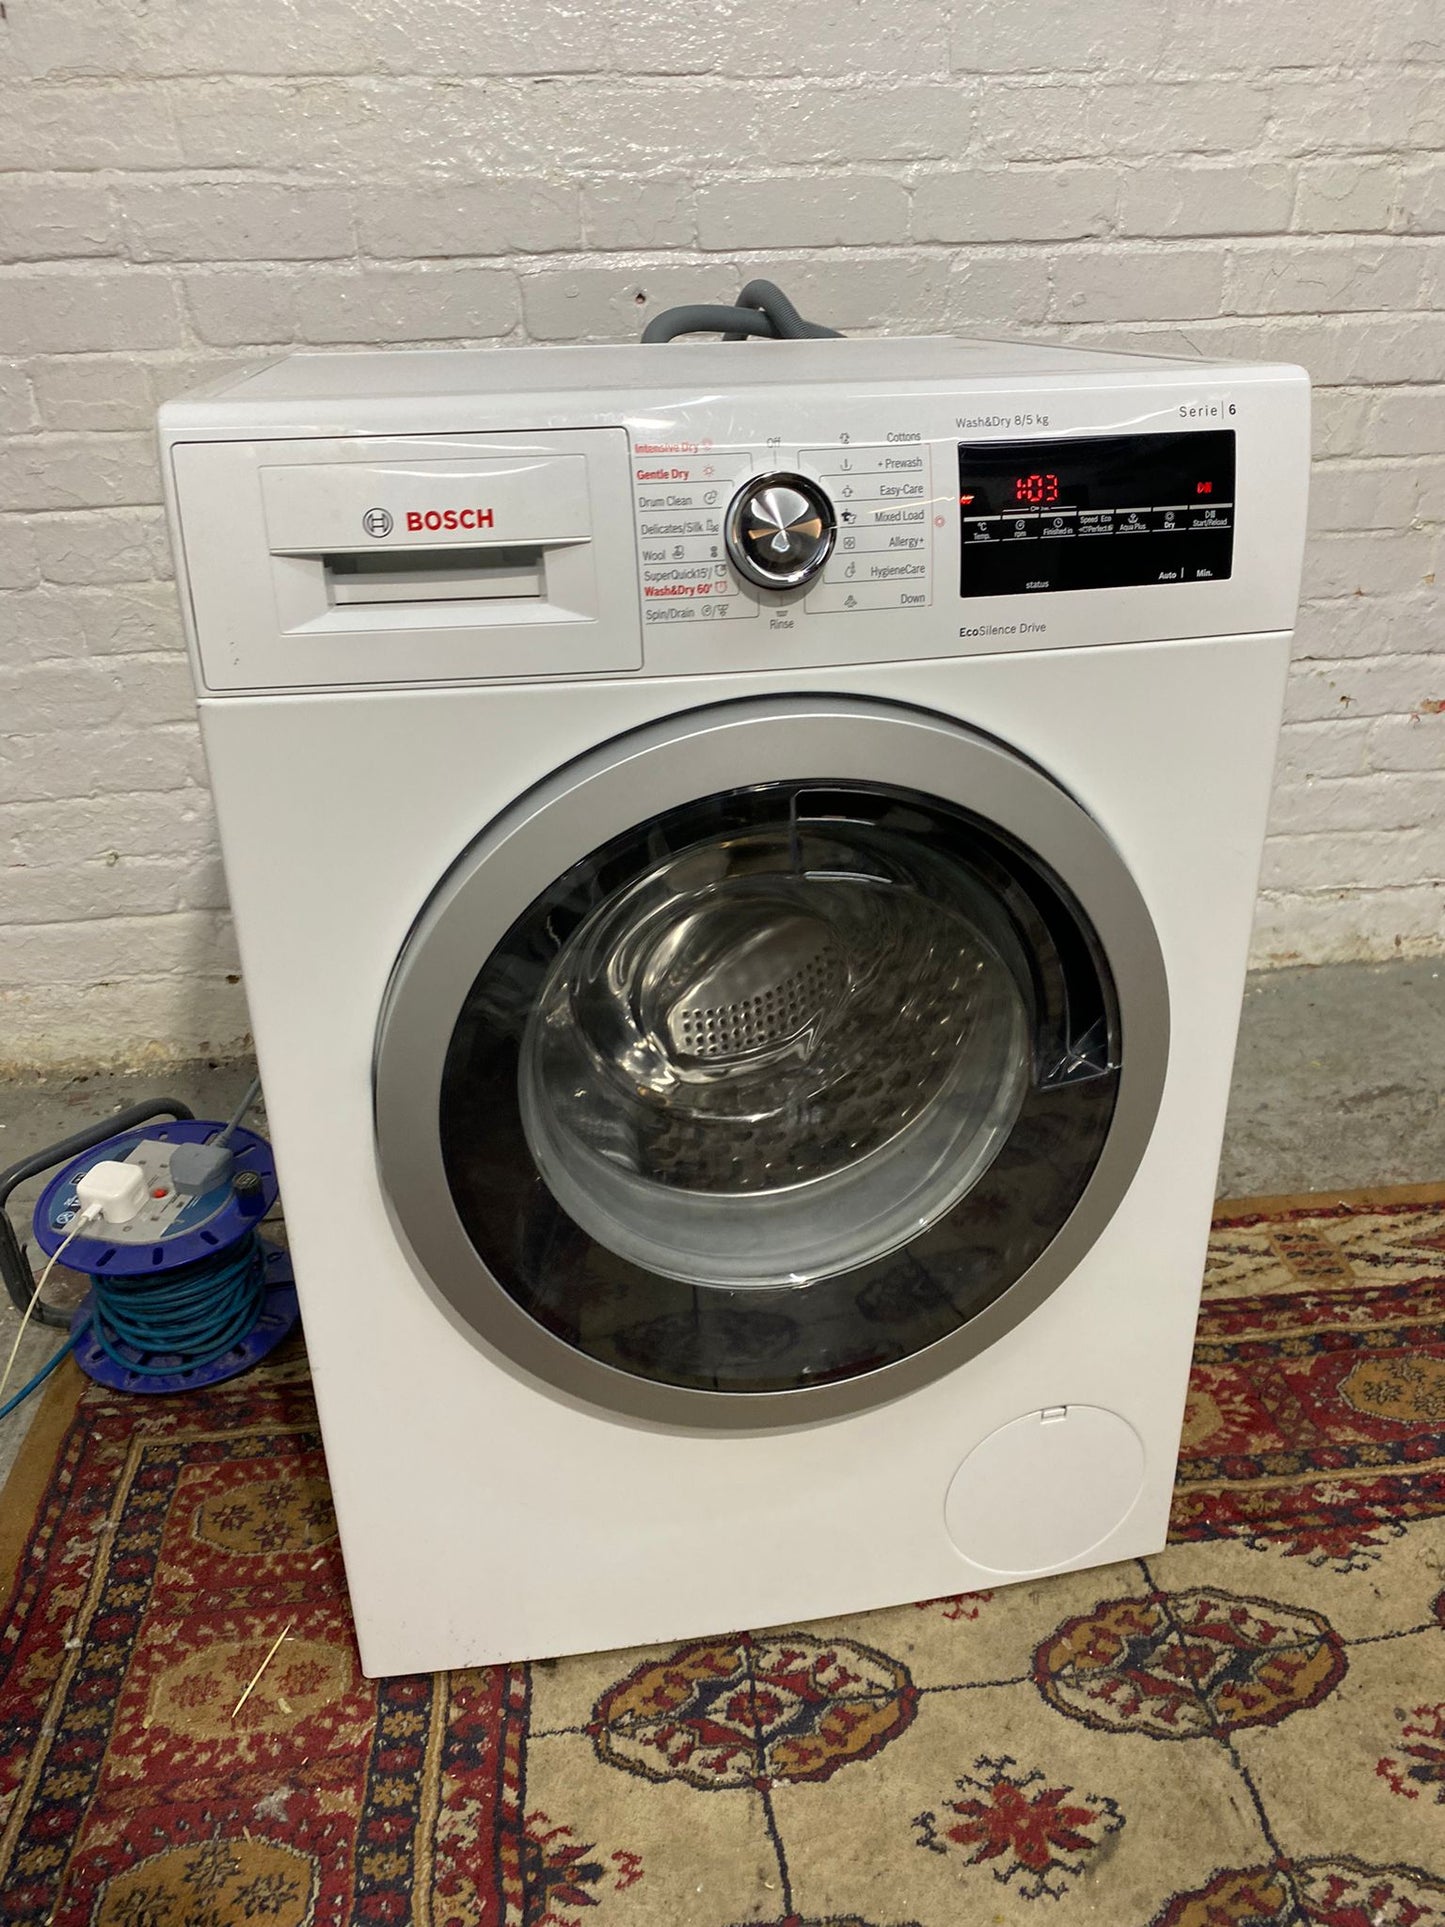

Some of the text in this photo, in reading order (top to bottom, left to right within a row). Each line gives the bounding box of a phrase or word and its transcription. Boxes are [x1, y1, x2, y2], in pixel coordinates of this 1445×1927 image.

[1179, 403, 1236, 417] Serie 6
[955, 414, 1049, 428] Wash&Dry 8/5 kg
[766, 437, 781, 448] Off
[886, 431, 921, 443] Cottons
[635, 441, 698, 454] Intensive Dry
[885, 457, 923, 469] Prewash
[637, 468, 689, 481] Gentle Dry
[879, 485, 924, 497] Easy-Care
[1016, 474, 1058, 502] 1:03
[639, 495, 693, 508] Drum Clean
[405, 508, 494, 532] BOSCH
[875, 509, 925, 522] Mixed Load
[640, 522, 703, 535] Delicates/Silk
[1164, 521, 1175, 529] Dry
[889, 536, 924, 548] Allergy+
[642, 549, 666, 561] Wool
[871, 564, 925, 578] HygieneCare
[1158, 572, 1177, 580] Auto
[644, 584, 695, 597] Wash&Dry
[1026, 580, 1049, 589] status
[901, 593, 925, 604] Down
[645, 607, 695, 622] Spin/Drain
[769, 618, 794, 630] Rinse
[959, 622, 1047, 637] EcoSilence Drive
